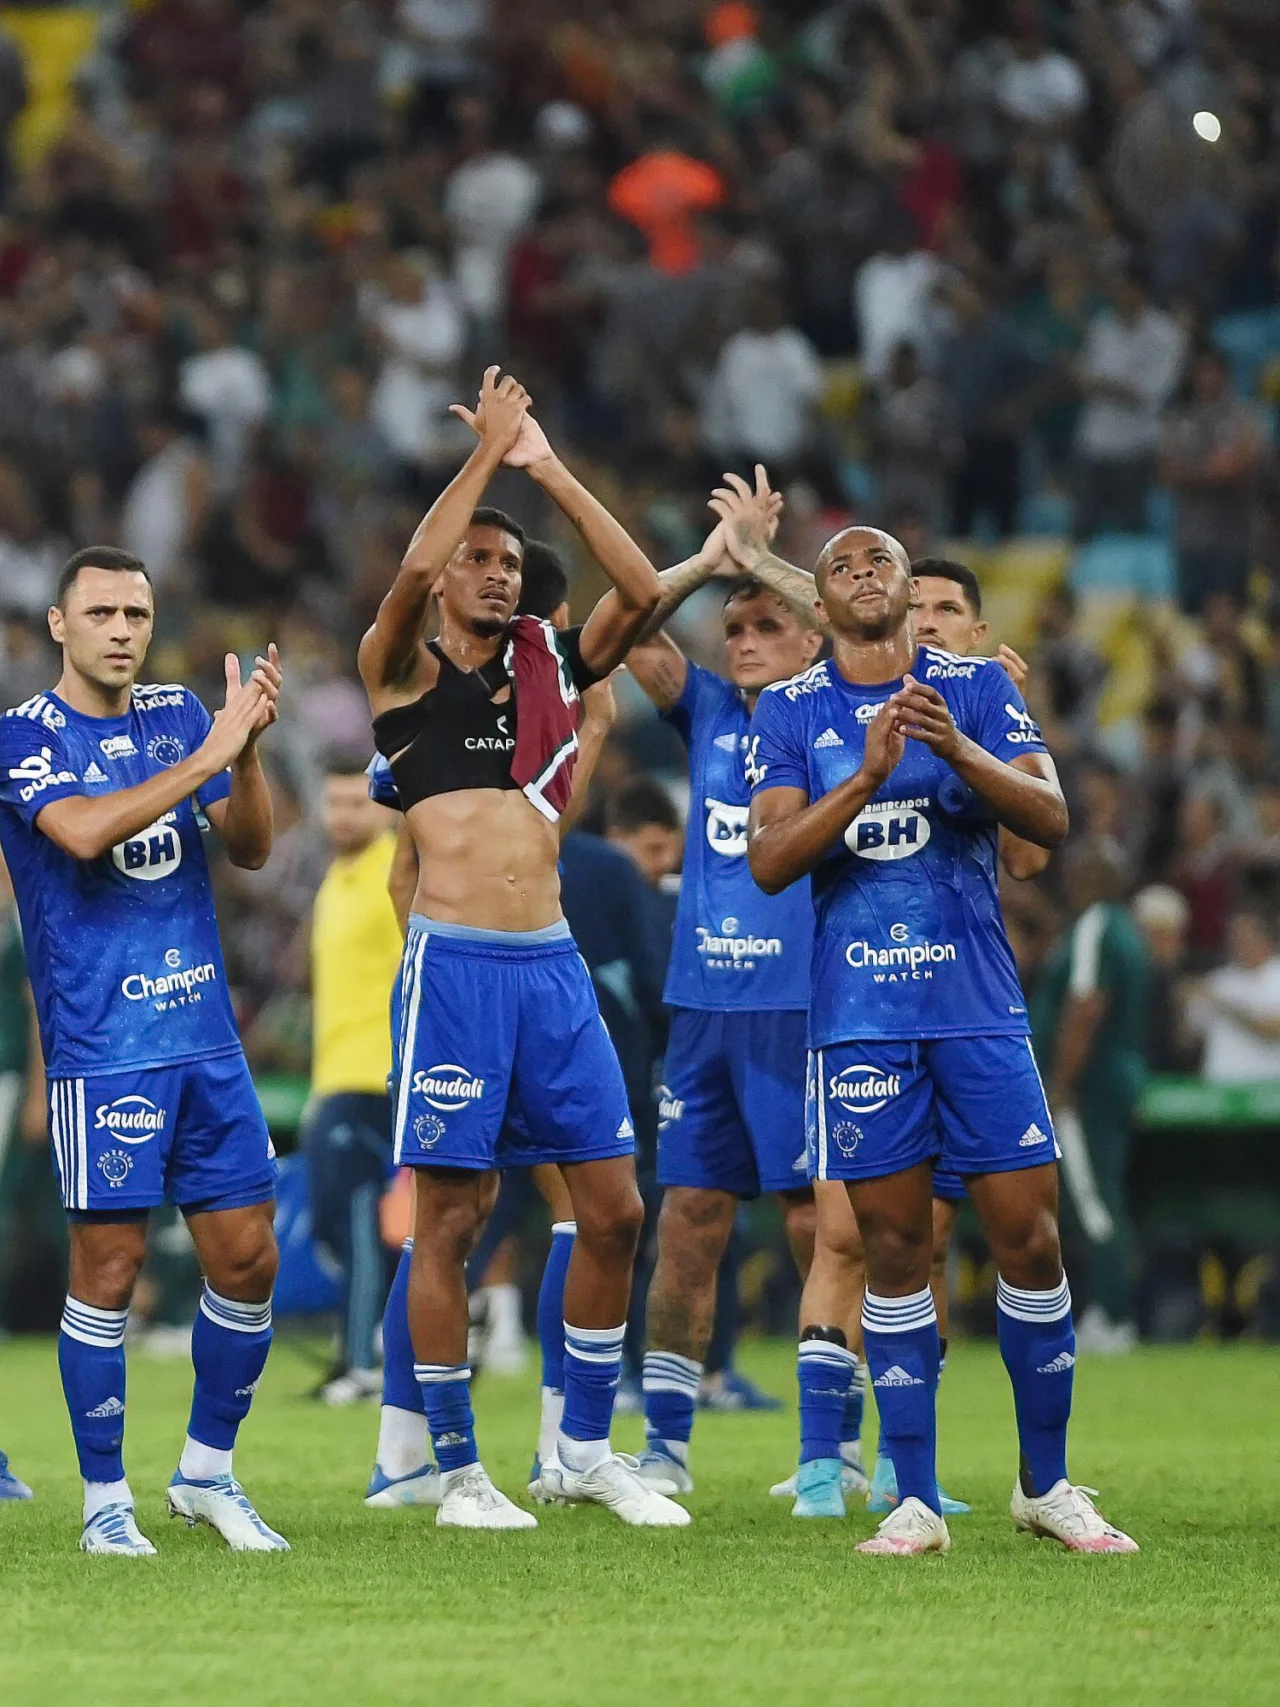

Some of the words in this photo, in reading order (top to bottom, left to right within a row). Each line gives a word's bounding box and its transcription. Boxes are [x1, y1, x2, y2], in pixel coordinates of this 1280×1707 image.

[146, 734, 184, 758] CRUZEIRO
[464, 737, 515, 751] CATAP
[813, 738, 844, 749] adidas
[861, 797, 930, 815] RMERCADOS
[856, 815, 919, 852] BH
[123, 832, 176, 871] BH
[846, 940, 957, 971] Champion
[873, 969, 934, 984] WATCH
[154, 992, 202, 1013] WATCH
[411, 1070, 485, 1100] Saudali
[828, 1074, 901, 1100] Saudali
[93, 1104, 167, 1131] Saudali
